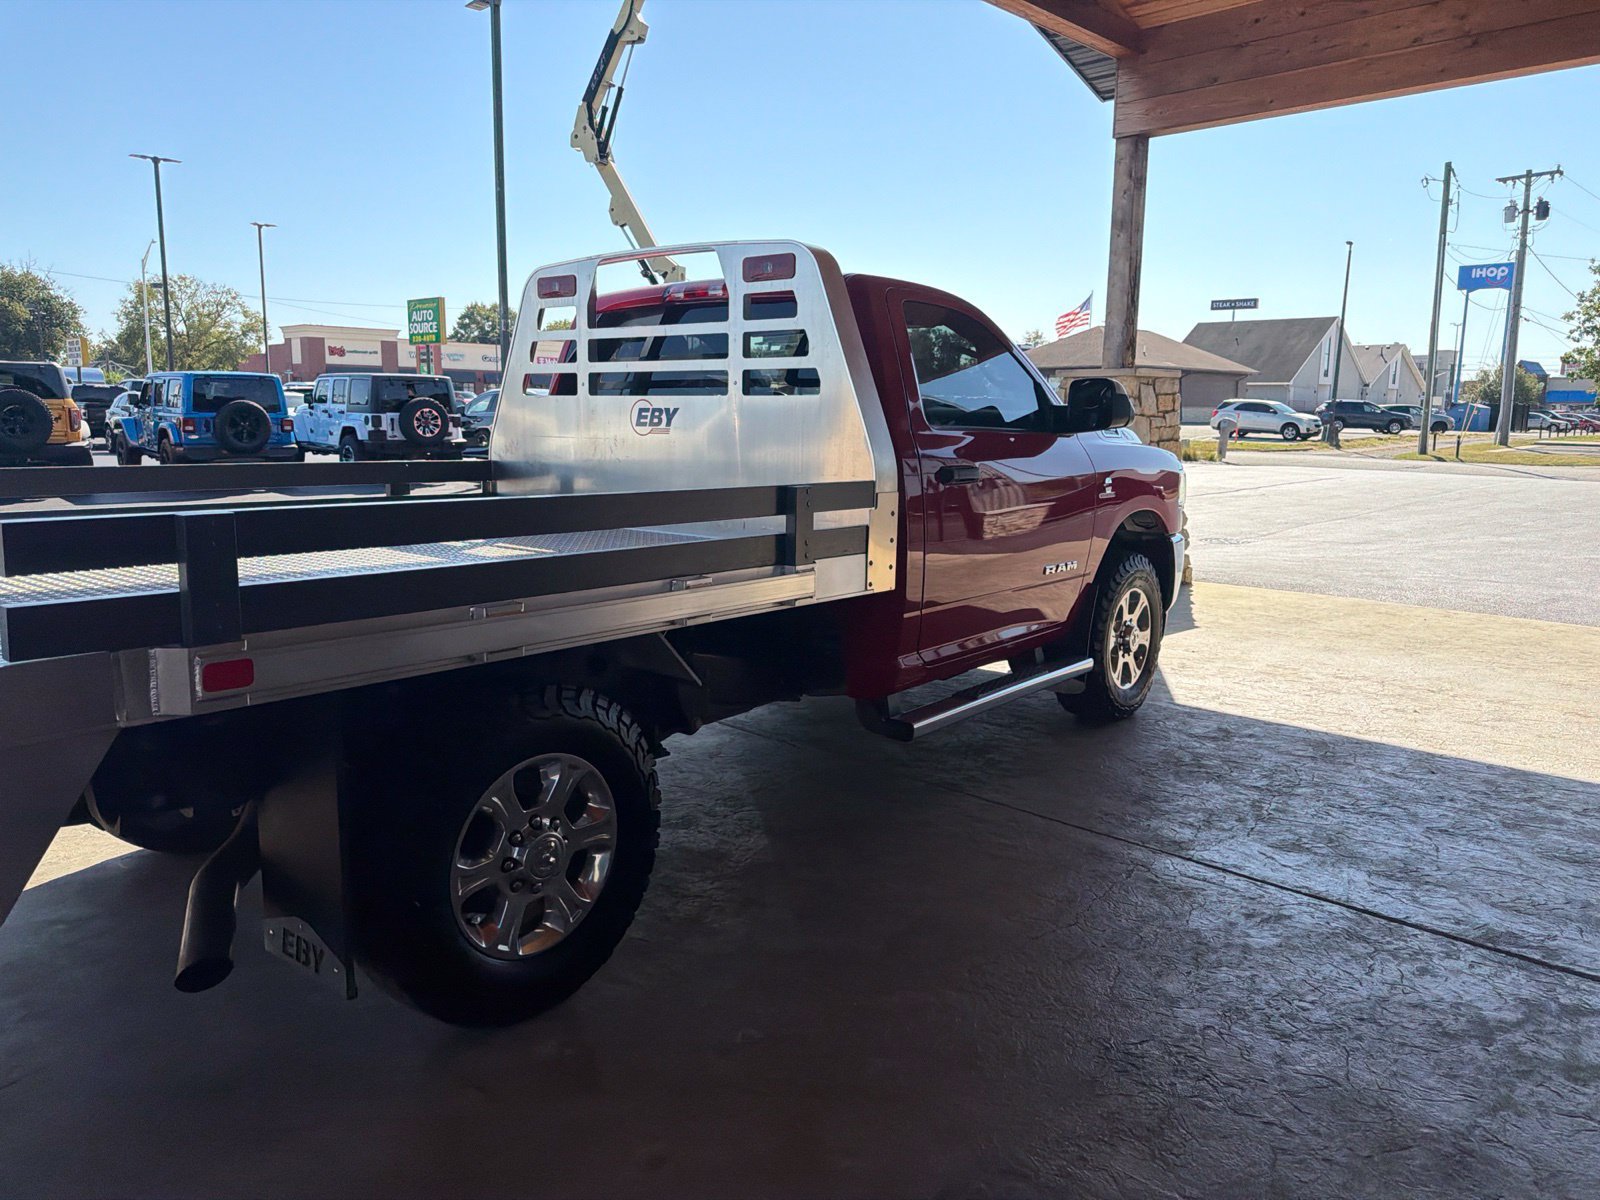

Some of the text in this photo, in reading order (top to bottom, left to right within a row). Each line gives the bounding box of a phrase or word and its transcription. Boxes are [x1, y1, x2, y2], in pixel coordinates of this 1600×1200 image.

[1471, 266, 1509, 281] IHOP
[411, 310, 434, 322] AUTO
[409, 322, 438, 334] SOURCE
[635, 407, 680, 428] EBY
[1043, 560, 1078, 576] RAM
[282, 927, 325, 974] EBY
